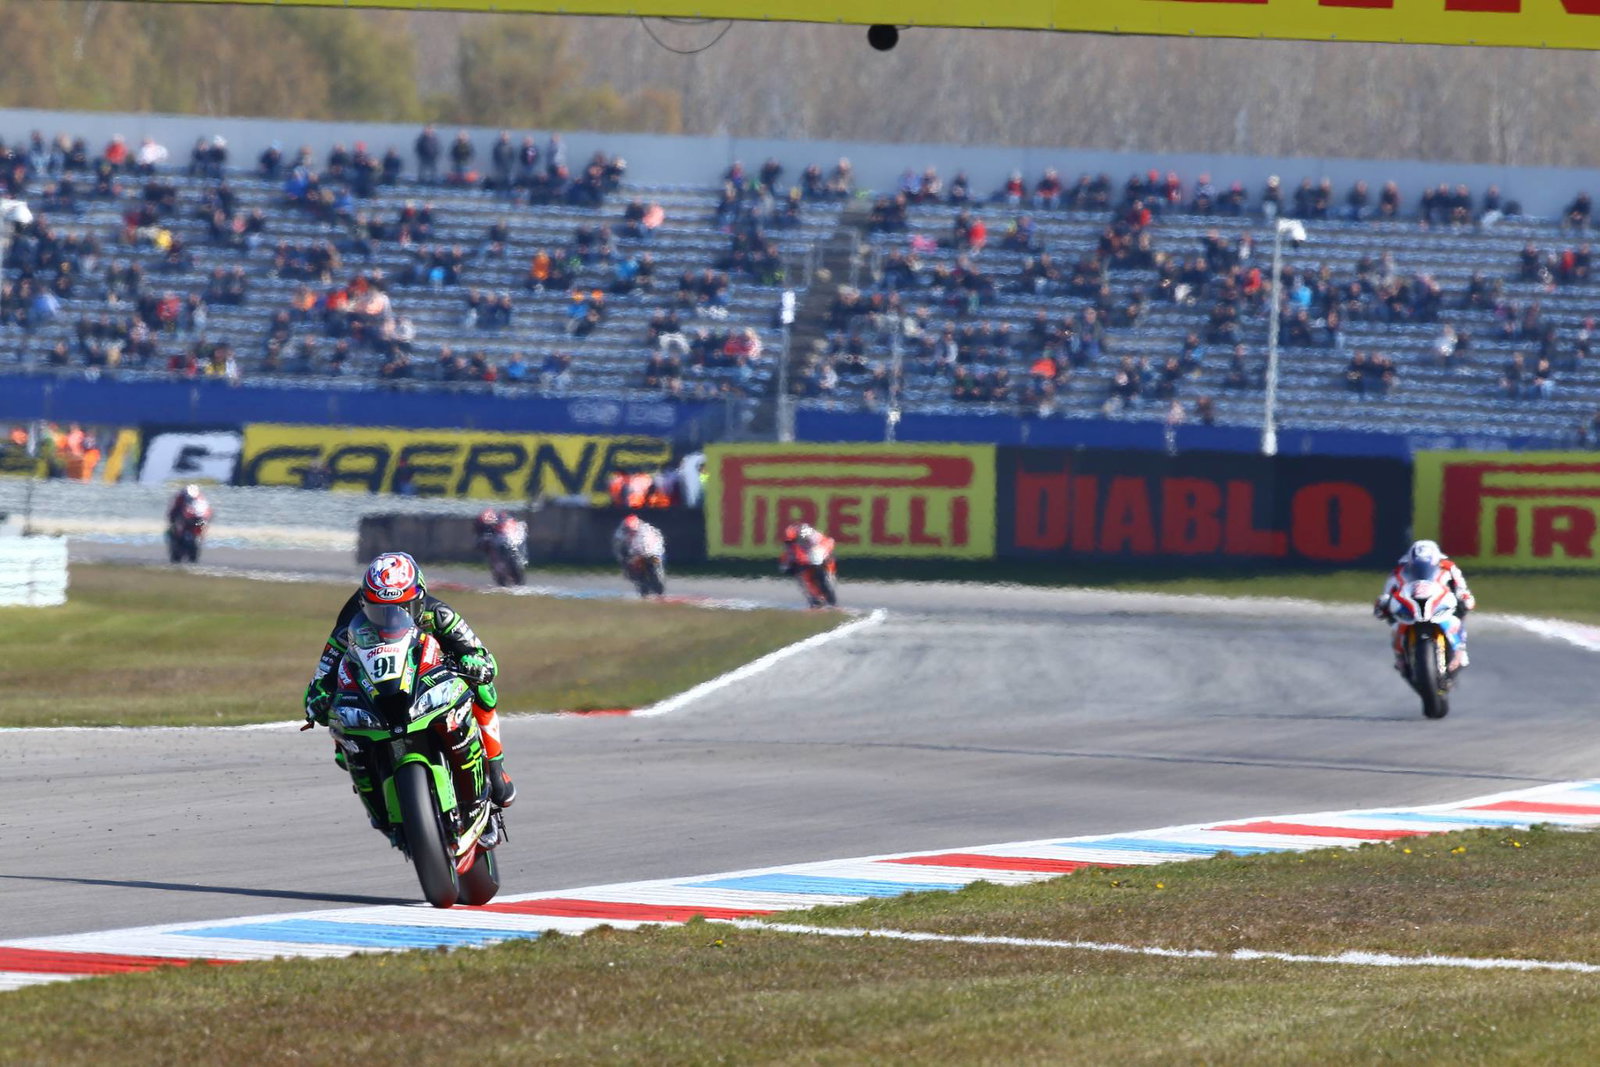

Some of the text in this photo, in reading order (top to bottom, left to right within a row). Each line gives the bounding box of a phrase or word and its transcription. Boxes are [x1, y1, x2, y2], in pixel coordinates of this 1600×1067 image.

[720, 454, 974, 547] PIRELLI
[1015, 452, 1374, 561] DIABLO
[379, 588, 400, 598] Arai
[373, 655, 397, 678] 91
